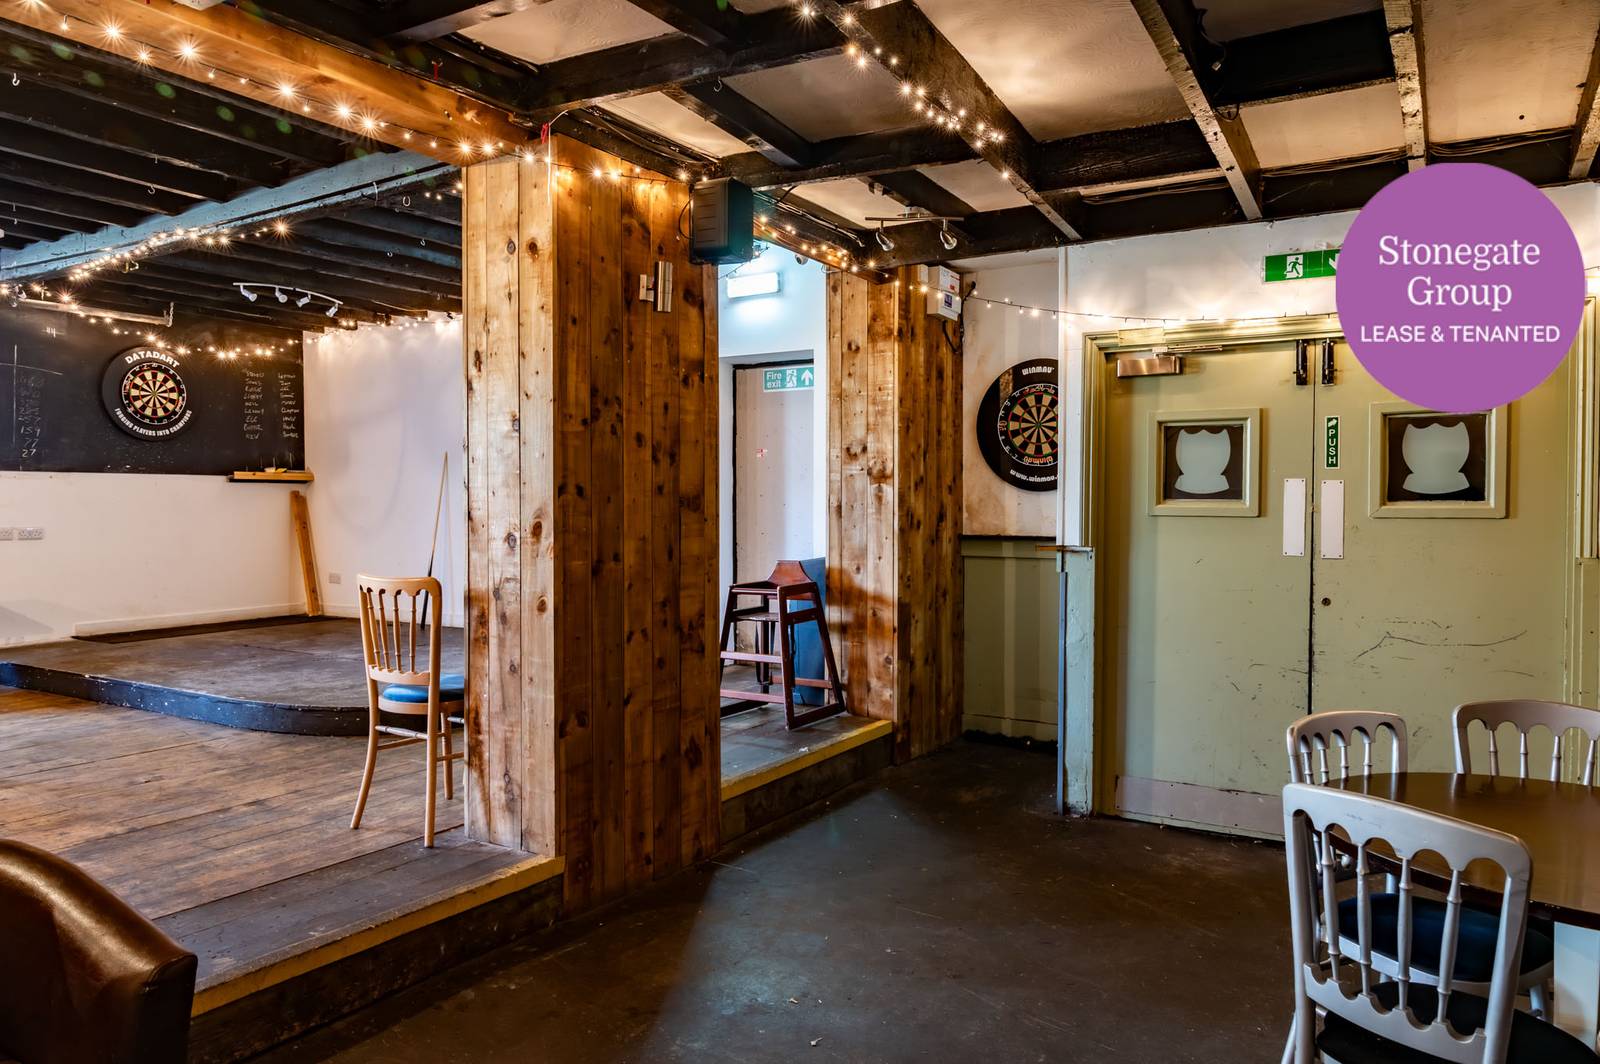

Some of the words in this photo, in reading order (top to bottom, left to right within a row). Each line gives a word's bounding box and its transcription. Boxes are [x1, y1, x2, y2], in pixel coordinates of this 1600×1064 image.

[124, 350, 180, 368] DATADART
[766, 371, 782, 380] Fire
[767, 380, 781, 389] exit
[114, 407, 134, 429] FORGING
[132, 425, 156, 437] PLAYERS
[156, 428, 170, 437] INTO
[169, 410, 193, 433] CHAMPIONS
[1328, 429, 1336, 464] PUSH
[1009, 468, 1059, 483] www.winmau.
